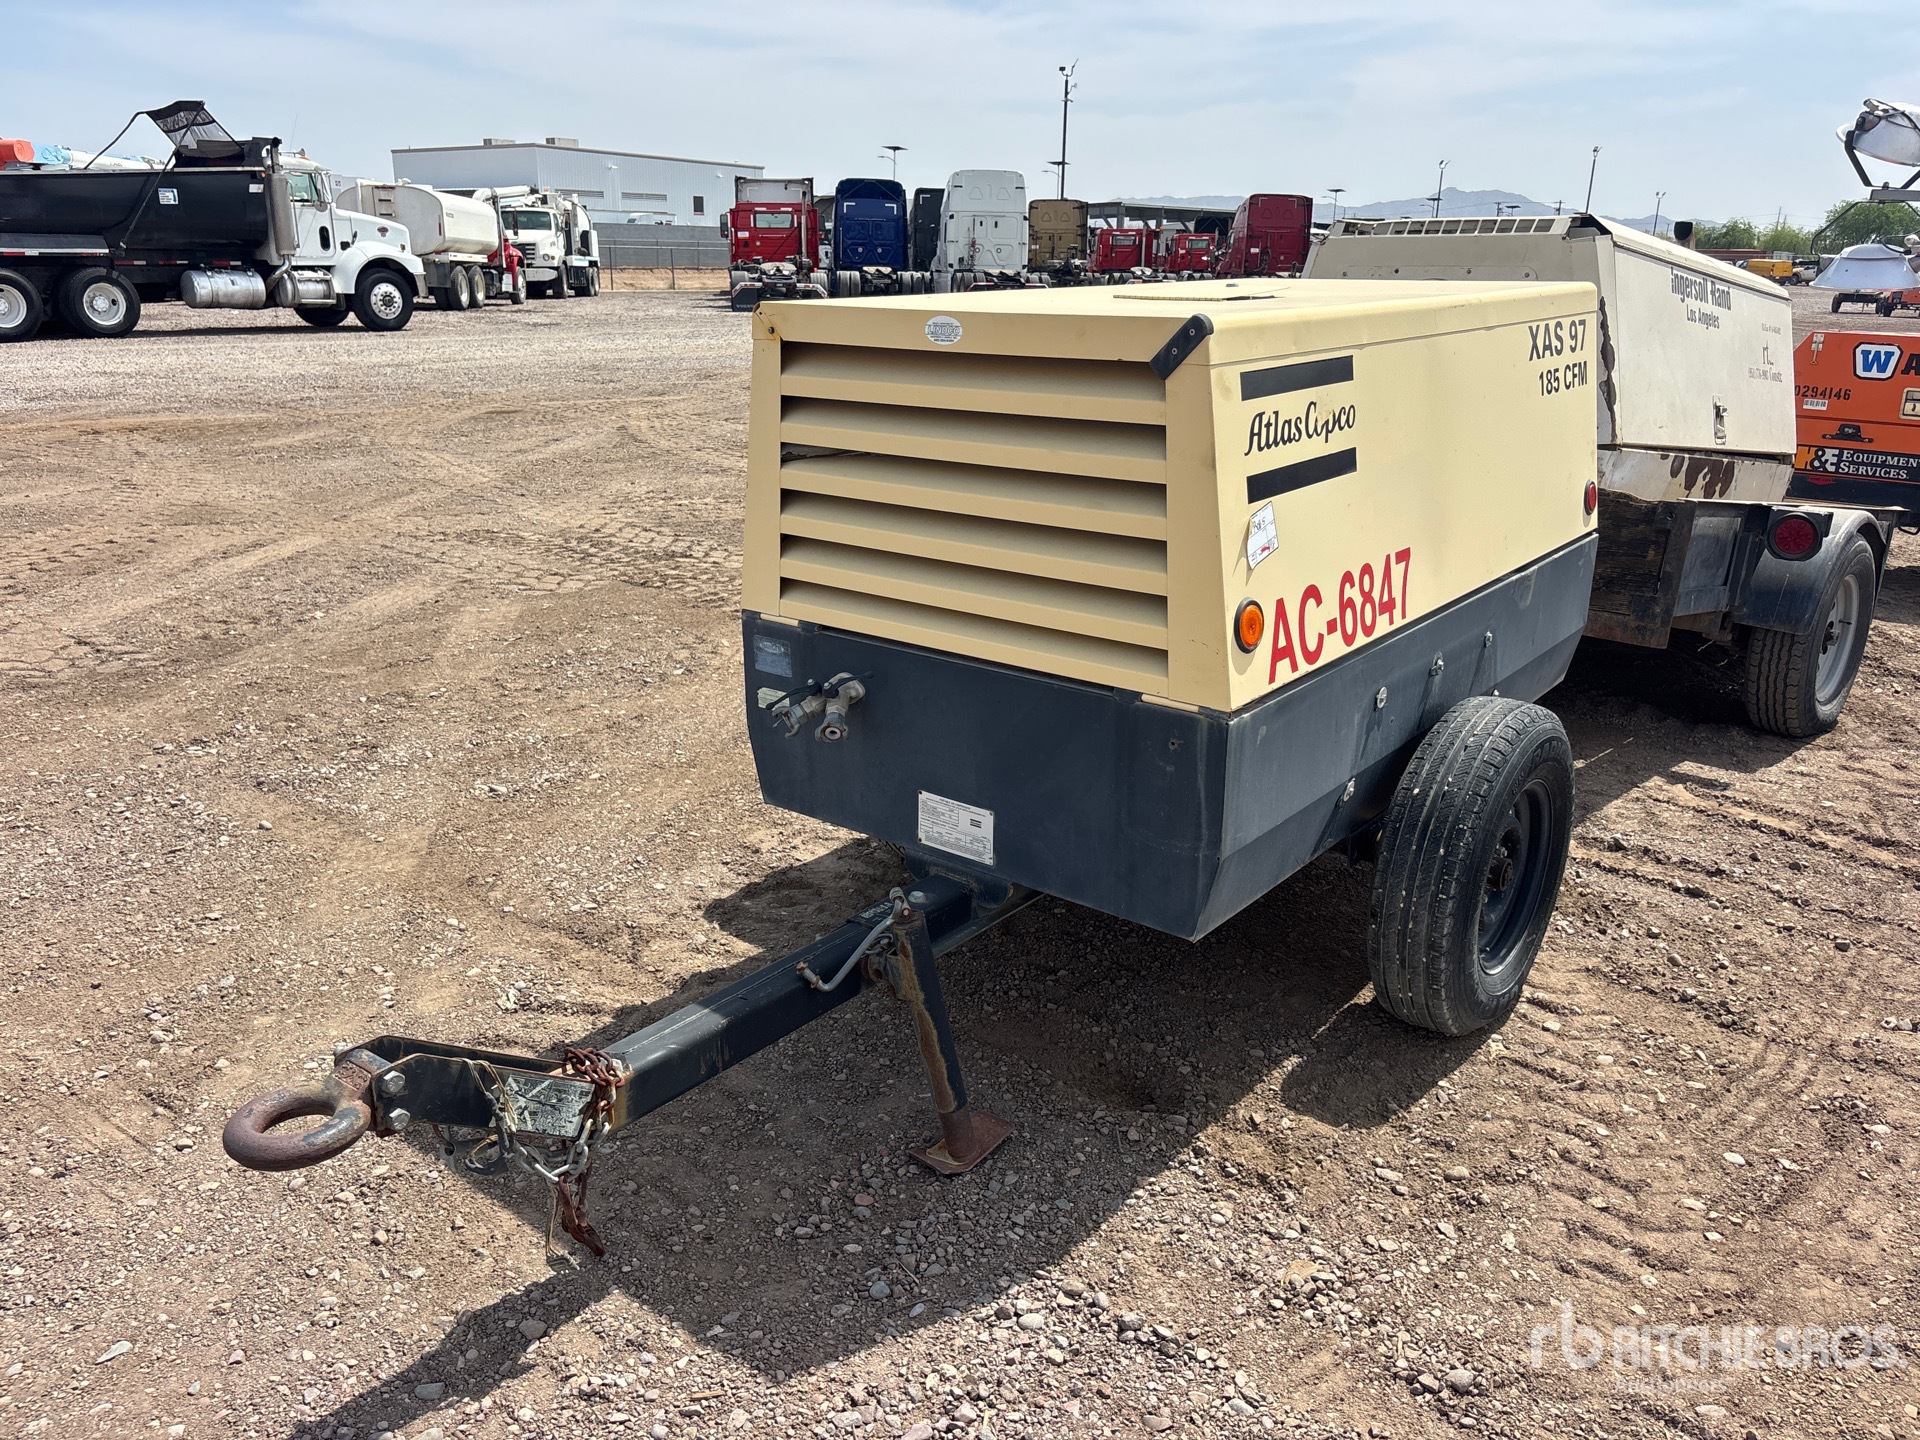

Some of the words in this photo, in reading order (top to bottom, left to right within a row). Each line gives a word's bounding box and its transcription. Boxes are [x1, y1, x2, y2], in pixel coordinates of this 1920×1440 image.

[1686, 304, 1697, 322] Los
[1698, 308, 1720, 330] Angeles
[1528, 320, 1564, 361] XAS
[1569, 319, 1586, 353] 97
[1539, 368, 1560, 396] 185
[1564, 361, 1587, 390] CFM
[1244, 409, 1303, 456] Atlas
[1305, 400, 1356, 444] Copco
[1841, 449, 1920, 468] EQUIPMEN
[1268, 547, 1411, 685] AC-6847
